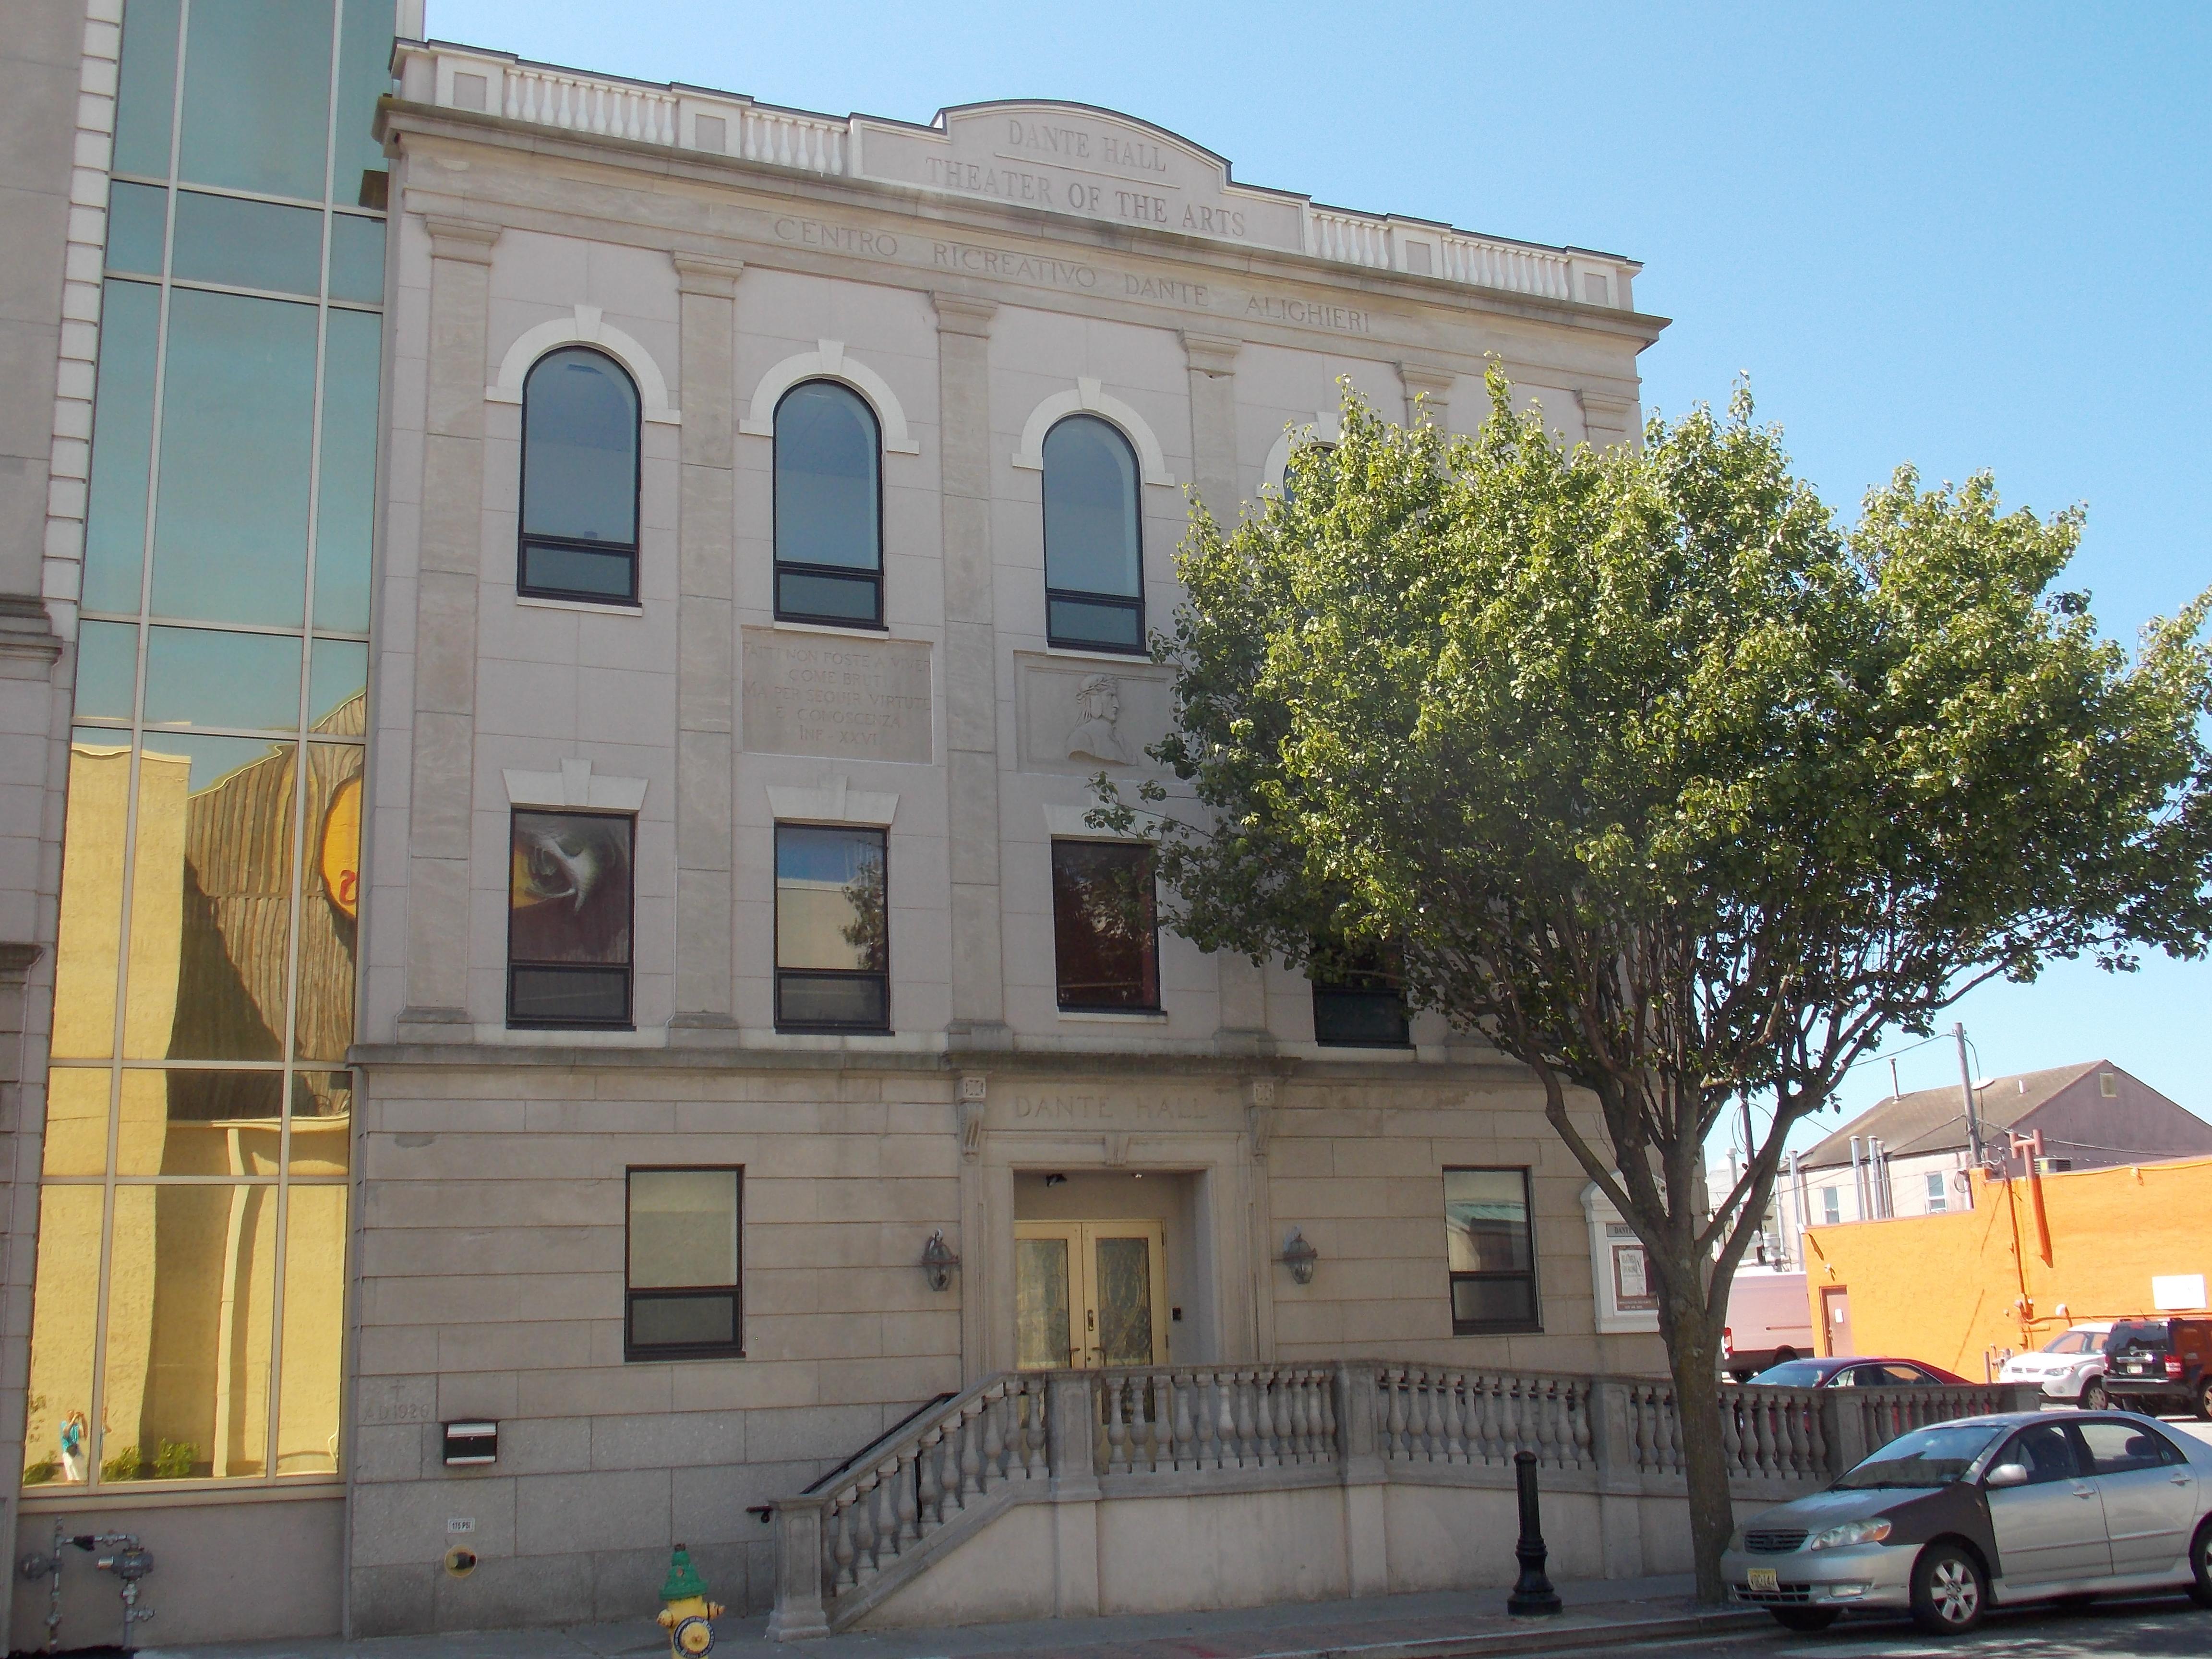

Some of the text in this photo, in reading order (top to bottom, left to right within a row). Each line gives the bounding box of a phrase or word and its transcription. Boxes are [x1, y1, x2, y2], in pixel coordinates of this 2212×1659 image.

[1009, 120, 1166, 172] DANTE HALL
[925, 156, 1246, 237] THEATER OF THE ARTS
[773, 217, 1370, 333] CENTRO RICREATIVO DANTE ALIGHIERI
[786, 649, 817, 662] NON
[824, 651, 869, 667] FOSTE
[789, 668, 836, 684] COME
[1014, 1095, 1209, 1119] DANTE HALL
